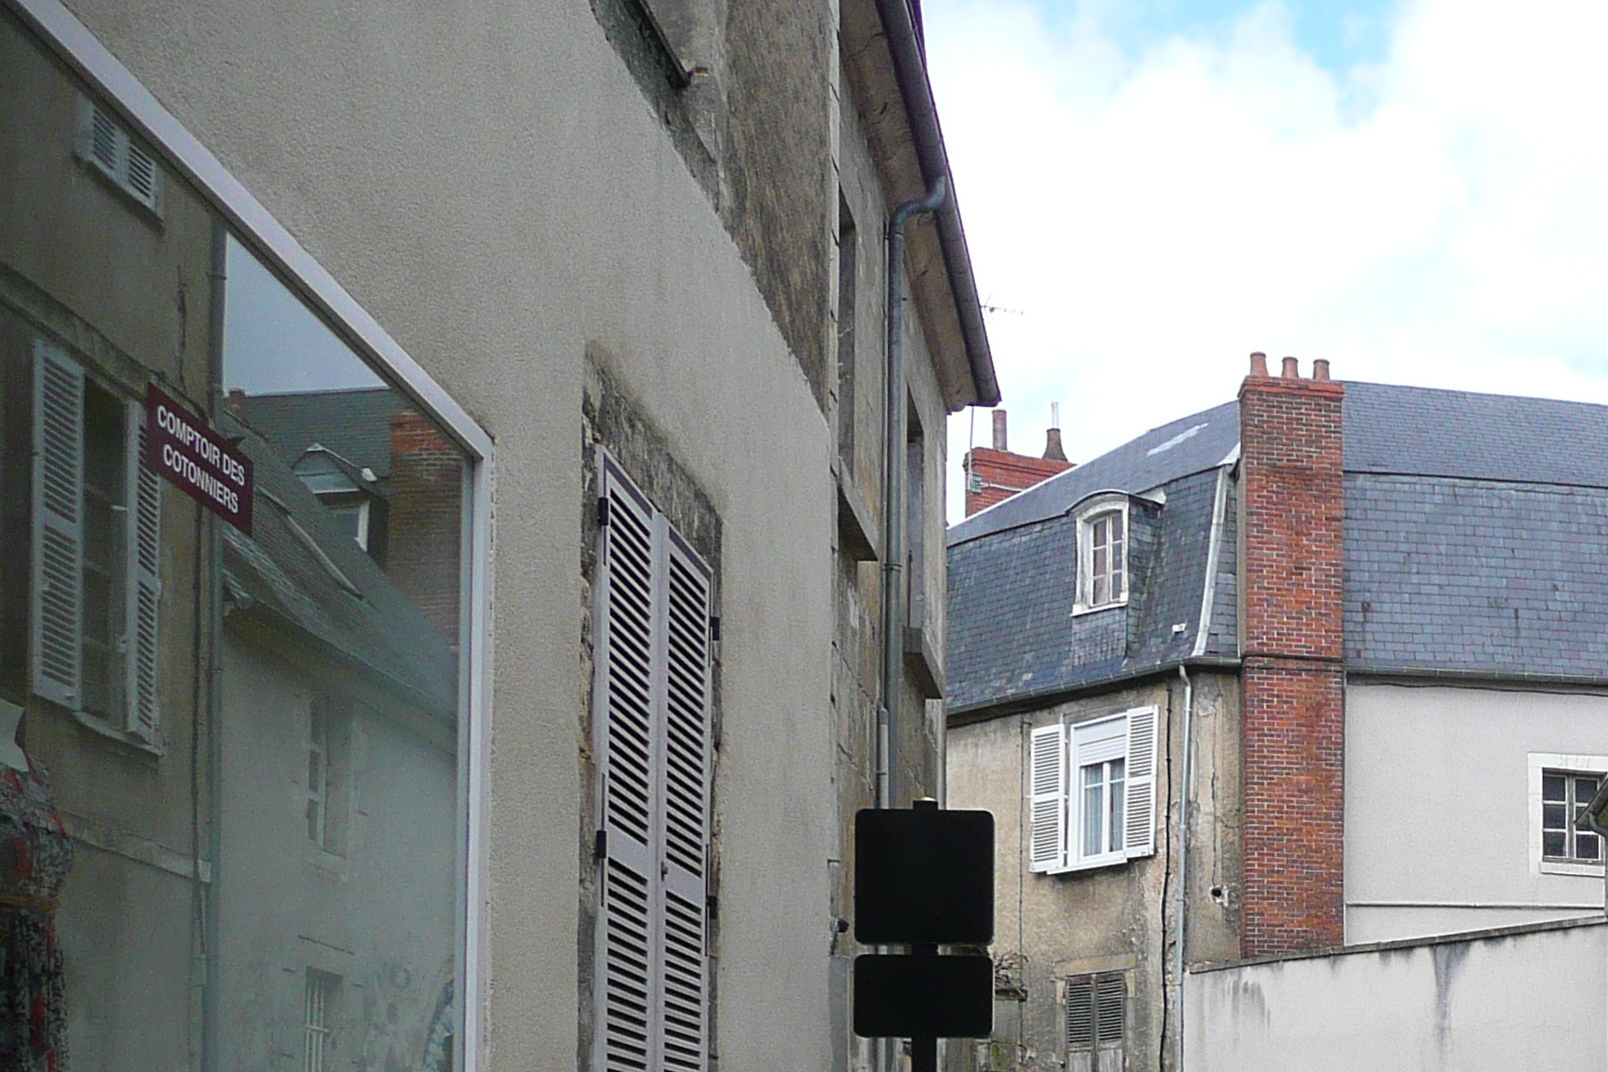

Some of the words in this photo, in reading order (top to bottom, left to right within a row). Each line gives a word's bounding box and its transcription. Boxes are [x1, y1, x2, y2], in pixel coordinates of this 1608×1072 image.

[157, 405, 221, 469] COMPTOIR
[222, 453, 245, 486] DES
[163, 444, 239, 513] COTONNIERS
